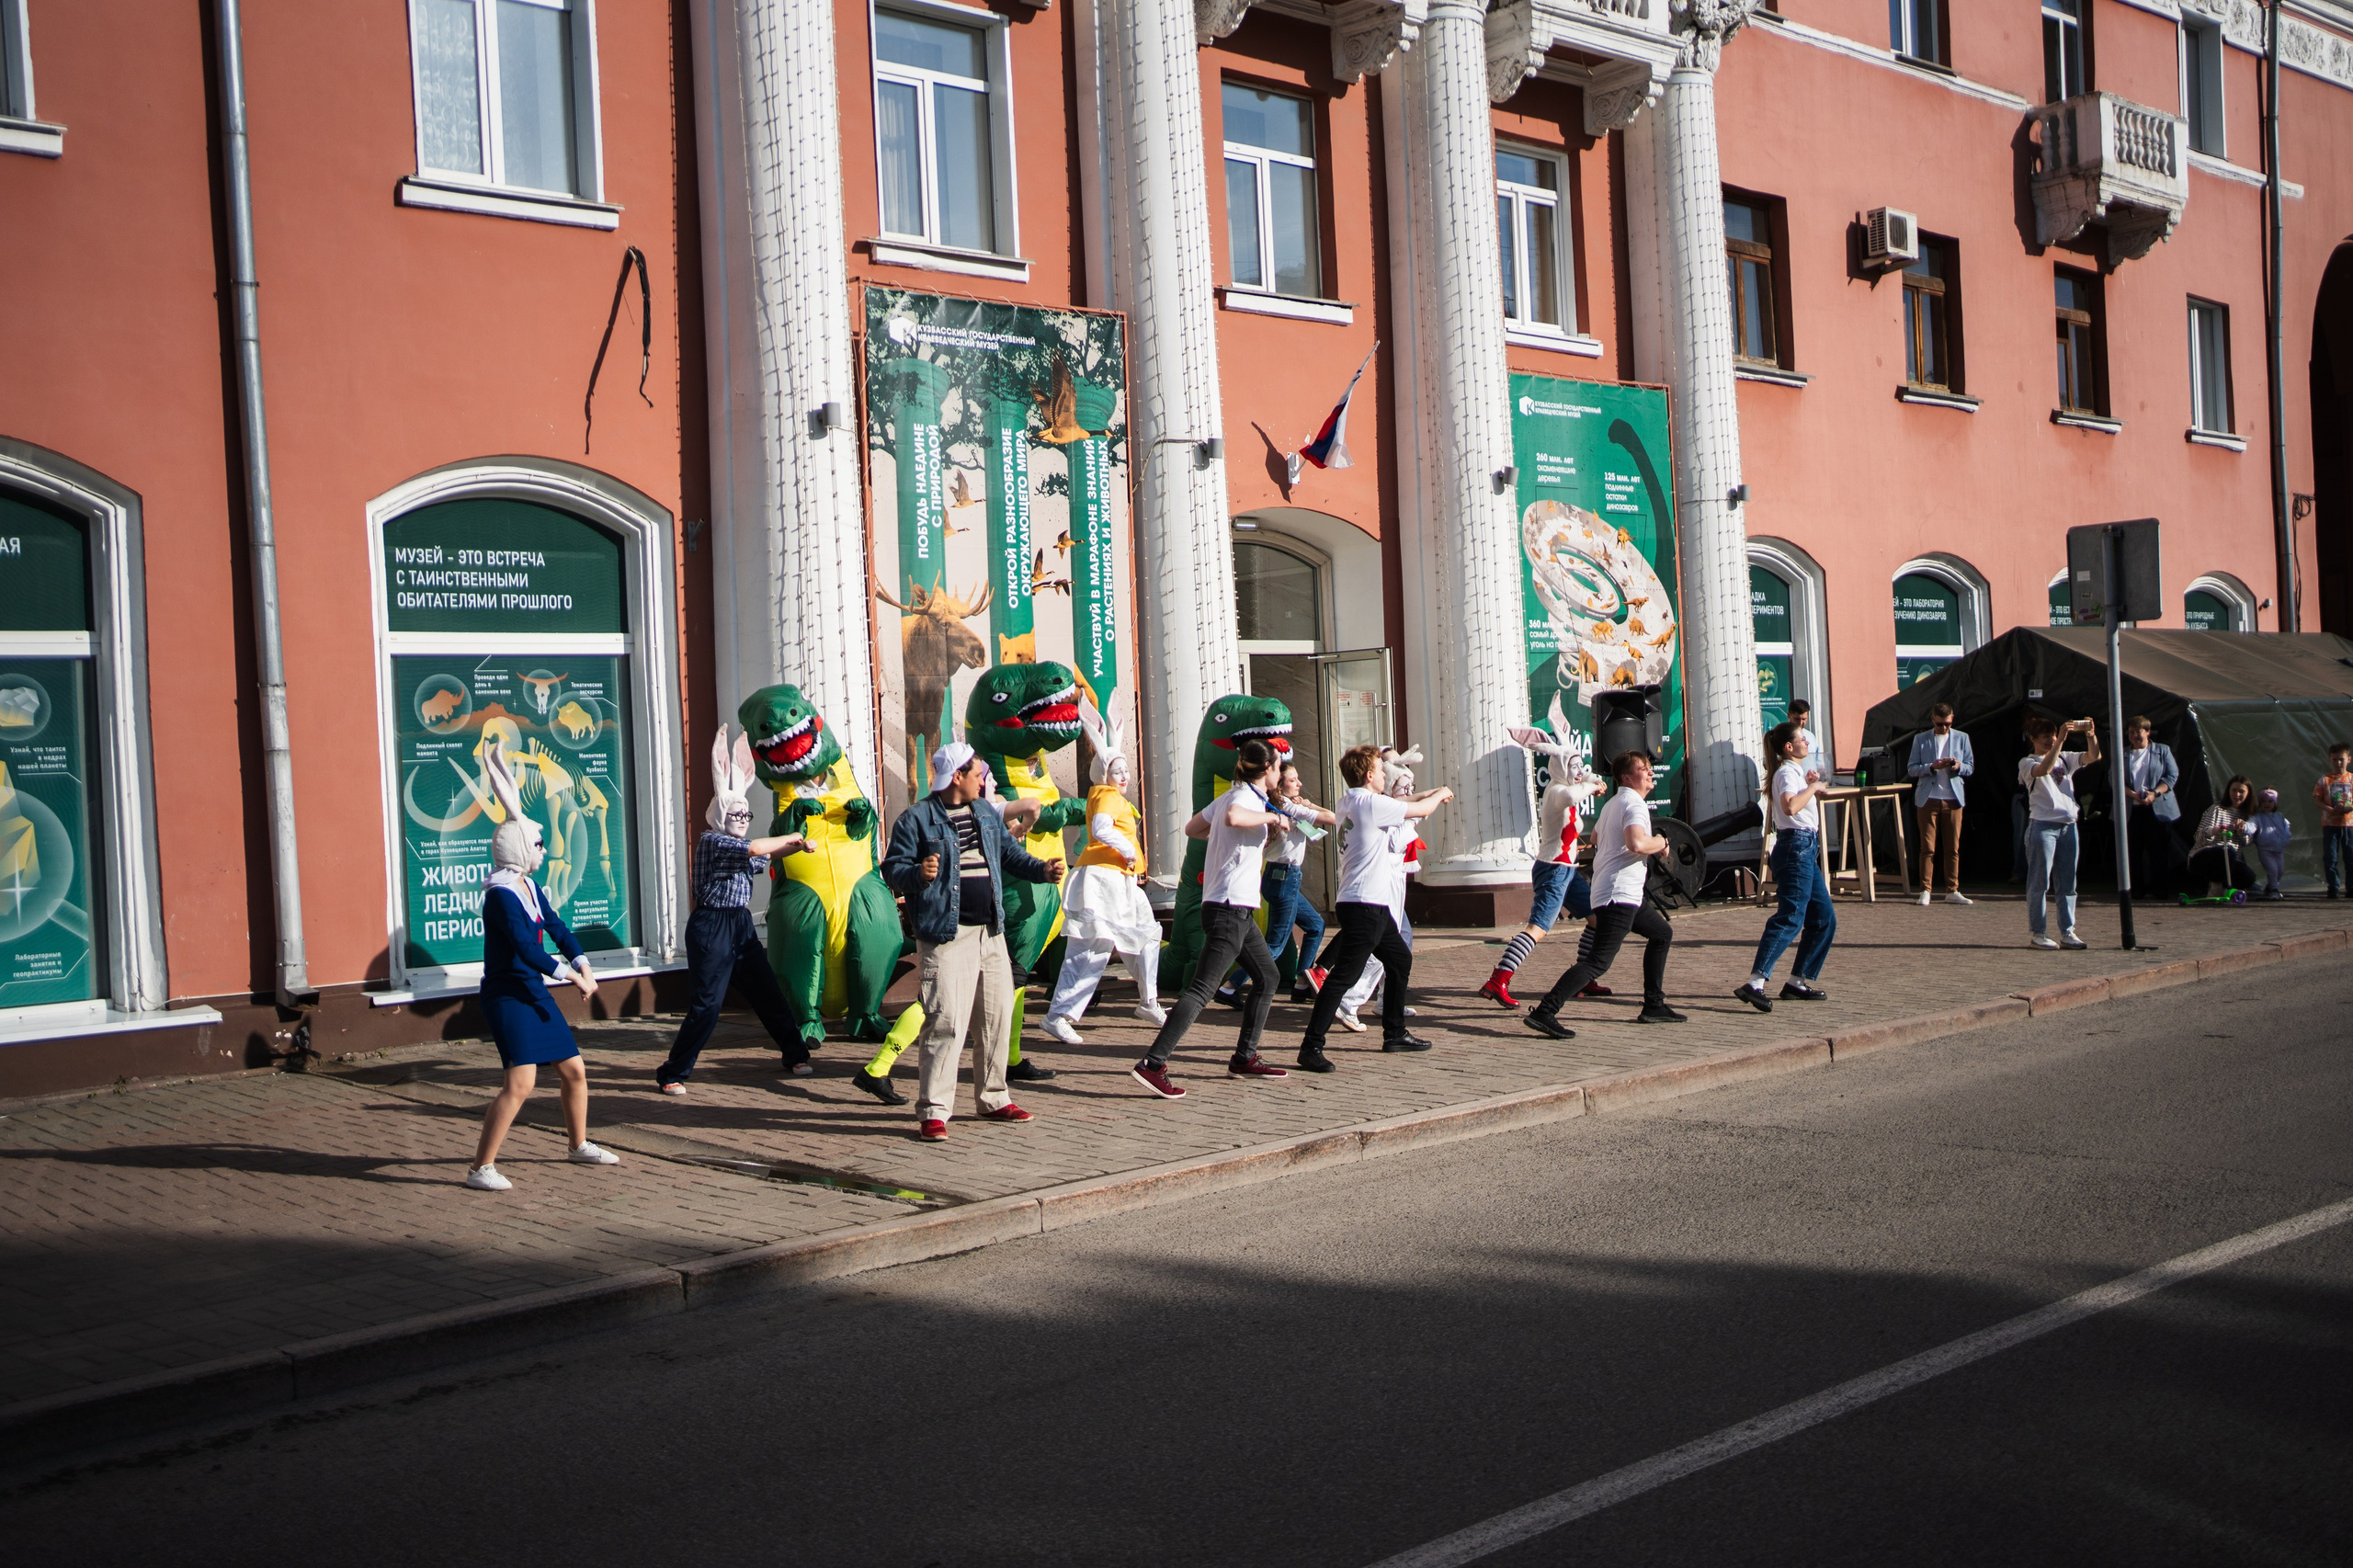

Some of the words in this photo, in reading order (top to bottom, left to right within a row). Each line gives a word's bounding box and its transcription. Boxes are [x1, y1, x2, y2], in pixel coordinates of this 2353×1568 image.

[917, 324, 968, 337] КУЗБАССКИЙ
[969, 330, 1036, 346] ГОСУДАРСТВЕННЫЙ
[917, 333, 974, 347] КРАЕВЕДЧЕСКИЙ
[976, 340, 999, 350] МУЗЕЙ
[1016, 429, 1027, 472] МИРА
[914, 423, 927, 494] НАЕДИНЕ
[1536, 452, 1548, 462] 260
[926, 424, 942, 510] ПРИРОДОЙ
[1082, 439, 1096, 499] ЗНАНИЙ
[1537, 464, 1576, 474] окаменевшие
[1097, 440, 1111, 524] ЖИВОТНЫХ
[1537, 474, 1561, 483] деревья
[1604, 472, 1616, 482] 125
[1002, 427, 1017, 544] РАЗНООБРАЗИЕ
[1605, 483, 1634, 493] подлинные
[1606, 493, 1627, 501] остатки
[1607, 503, 1638, 513] динозавров
[931, 515, 942, 528] С
[916, 497, 929, 559] ПОБУДЬ
[1102, 528, 1111, 539] И
[1017, 475, 1032, 597] ОКРУЖАЮЩЕГО
[0, 537, 21, 553] АЯ
[1087, 503, 1101, 585] МАРАФОНЕ
[395, 545, 443, 563] МУЗЕЙ
[458, 550, 483, 565] ЭТО
[487, 551, 546, 567] ВСТРЕЧА
[396, 570, 405, 585] С
[408, 570, 529, 588] ТАИНСТВЕННЫМИ
[1005, 550, 1019, 609] ОТКРОЙ
[1102, 543, 1115, 626] РАСТЕНИЯХ
[1091, 589, 1101, 598] В
[397, 592, 497, 608] ОБИТАТЕЛЯМИ
[501, 595, 573, 609] ПРОШЛОГО
[1904, 597, 1912, 608] ЭТО
[1913, 598, 1945, 608] ЛАБОРАТОРИЯ
[1916, 610, 1947, 621] ДИНОЗАВРОВ
[1529, 619, 1540, 629] 360
[1105, 629, 1115, 642] О
[1529, 630, 1550, 638] самый
[1088, 603, 1104, 678] УЧАСТВУЙ
[1529, 641, 1546, 650] уголь
[415, 742, 446, 750] Подлинный
[585, 766, 608, 774] Кузбасса
[448, 838, 477, 846] образуются
[440, 846, 470, 855] Кузнецкого
[572, 914, 602, 922] путешествии
[424, 917, 485, 941] ПЕРИО
[15, 952, 62, 960] Лабораторные
[13, 968, 63, 978] геопрактикумы
